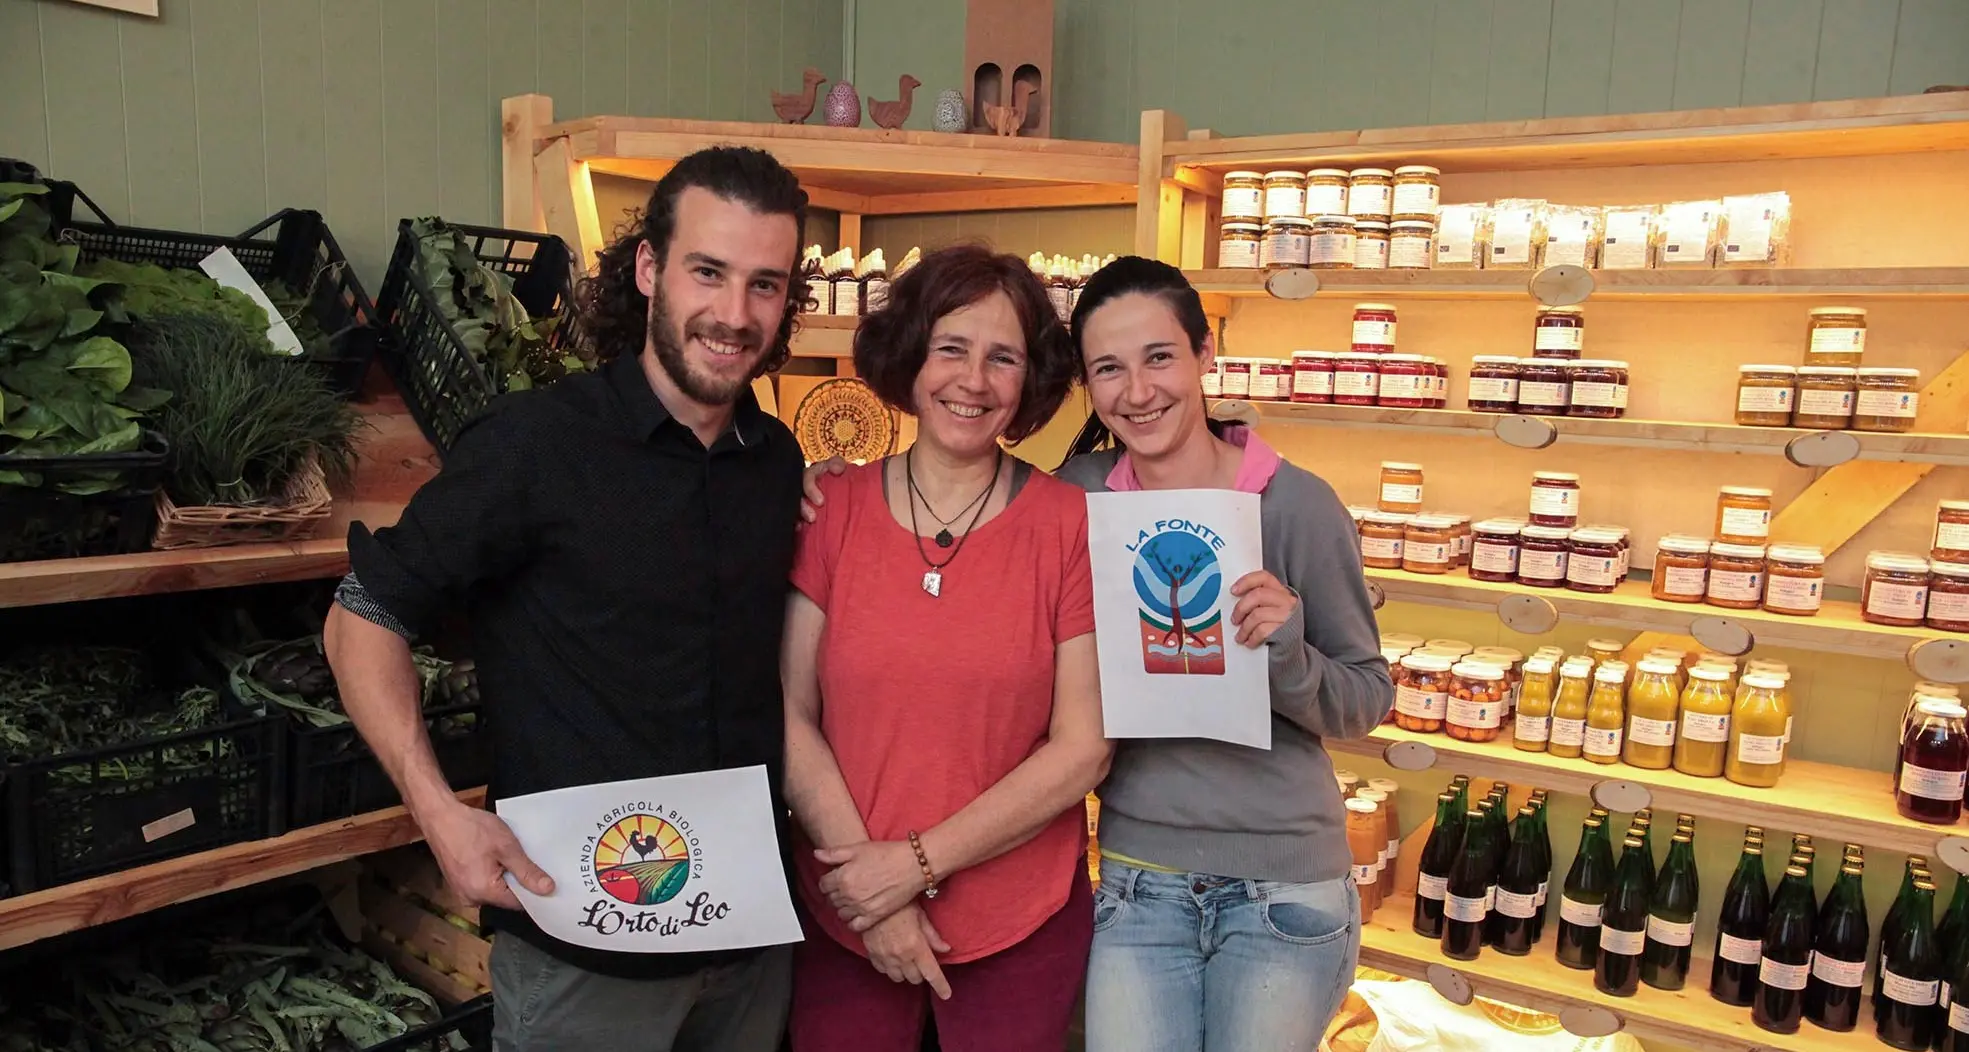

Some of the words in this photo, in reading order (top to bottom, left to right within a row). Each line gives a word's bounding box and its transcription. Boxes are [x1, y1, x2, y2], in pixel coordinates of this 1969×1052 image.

[1125, 529, 1149, 552] LA
[1155, 519, 1226, 551] FONTE
[580, 835, 598, 893] AZIENDA
[596, 801, 663, 831] AGRICOLA
[669, 810, 703, 880] BIOLOGICA
[577, 899, 660, 935] L'Orto
[660, 916, 680, 936] di
[681, 891, 731, 927] Leo
